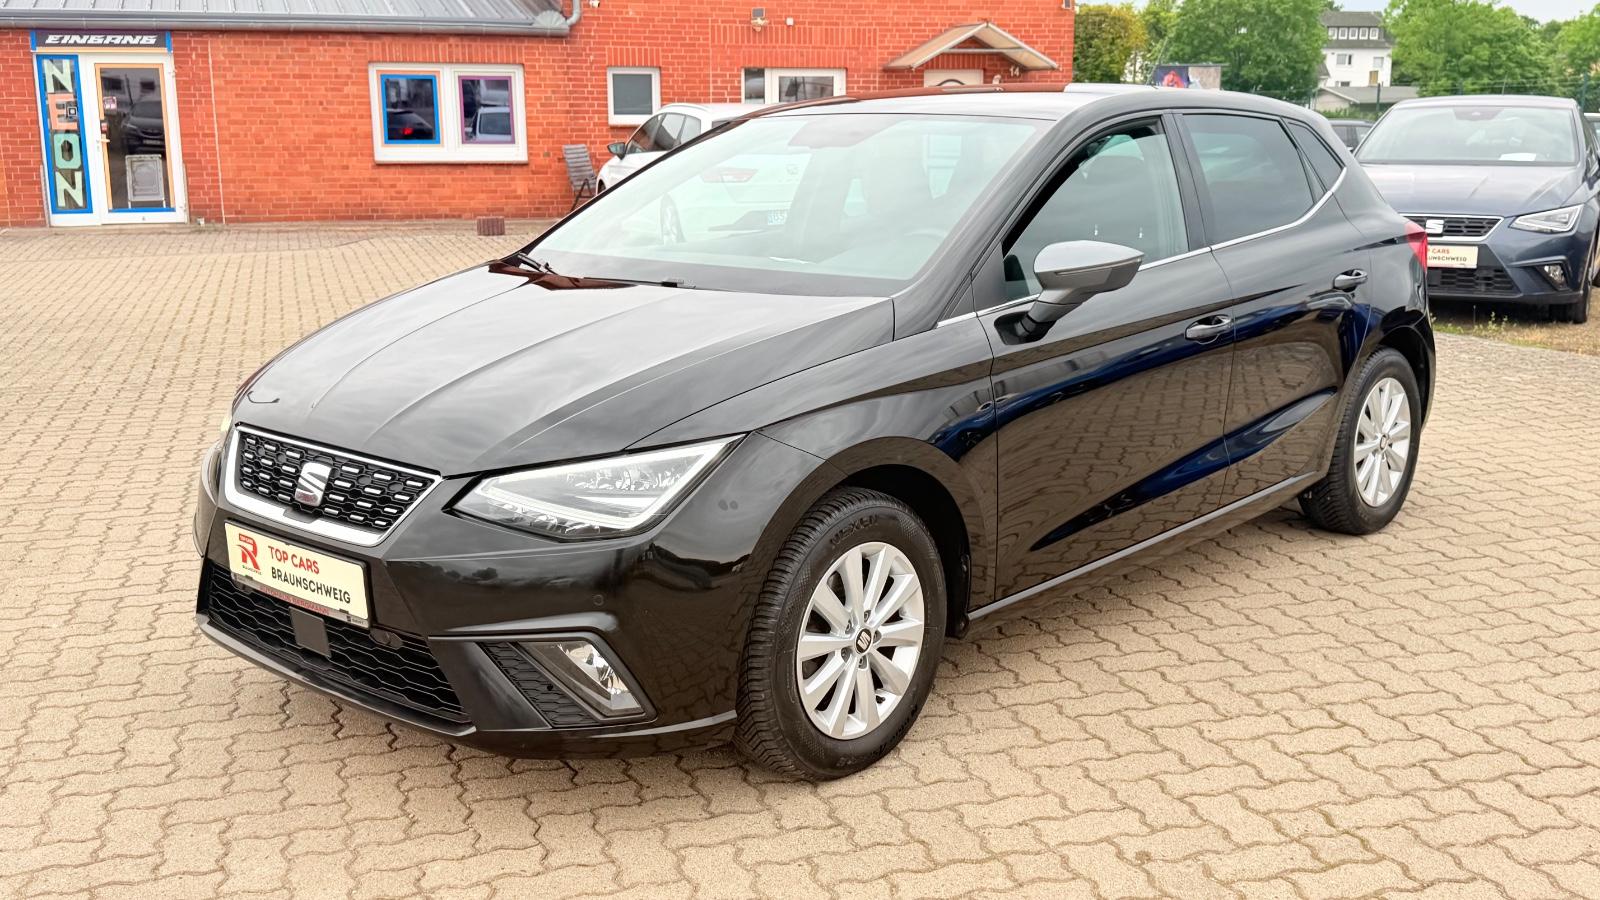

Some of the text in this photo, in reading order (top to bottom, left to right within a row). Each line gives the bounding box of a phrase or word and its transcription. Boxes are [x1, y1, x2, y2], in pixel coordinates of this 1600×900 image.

[45, 34, 156, 45] EINGANG
[1009, 66, 1020, 77] 14
[44, 59, 83, 206] NEON
[268, 545, 320, 575] TOP CARS
[271, 566, 351, 604] BRAUNSCHWEIG
